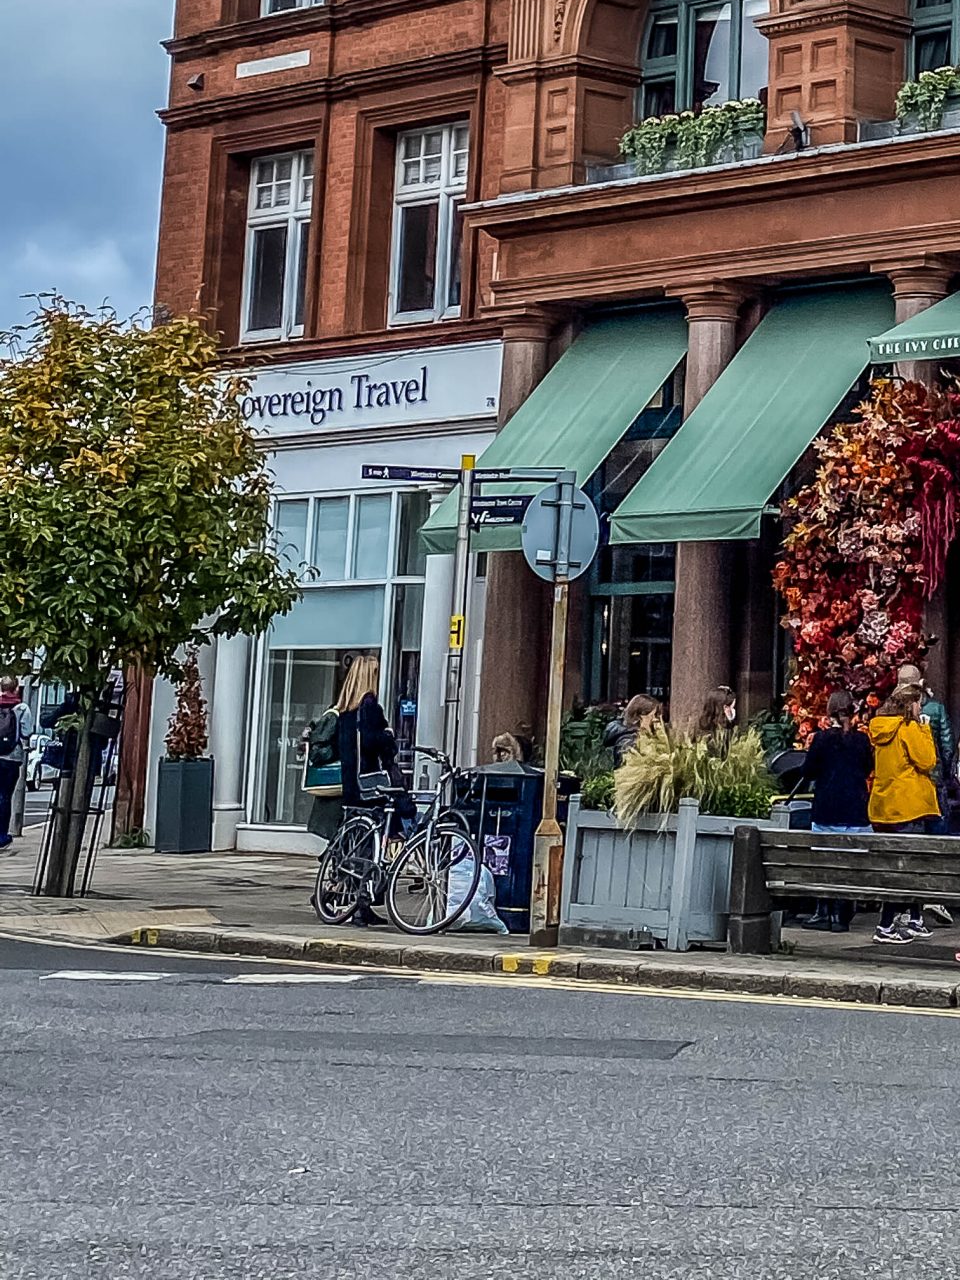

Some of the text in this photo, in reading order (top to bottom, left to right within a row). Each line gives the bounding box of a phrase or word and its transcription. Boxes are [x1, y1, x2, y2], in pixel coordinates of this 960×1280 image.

[878, 342, 900, 355] THE
[905, 340, 928, 353] IVY
[238, 366, 428, 425] overeign Travel
